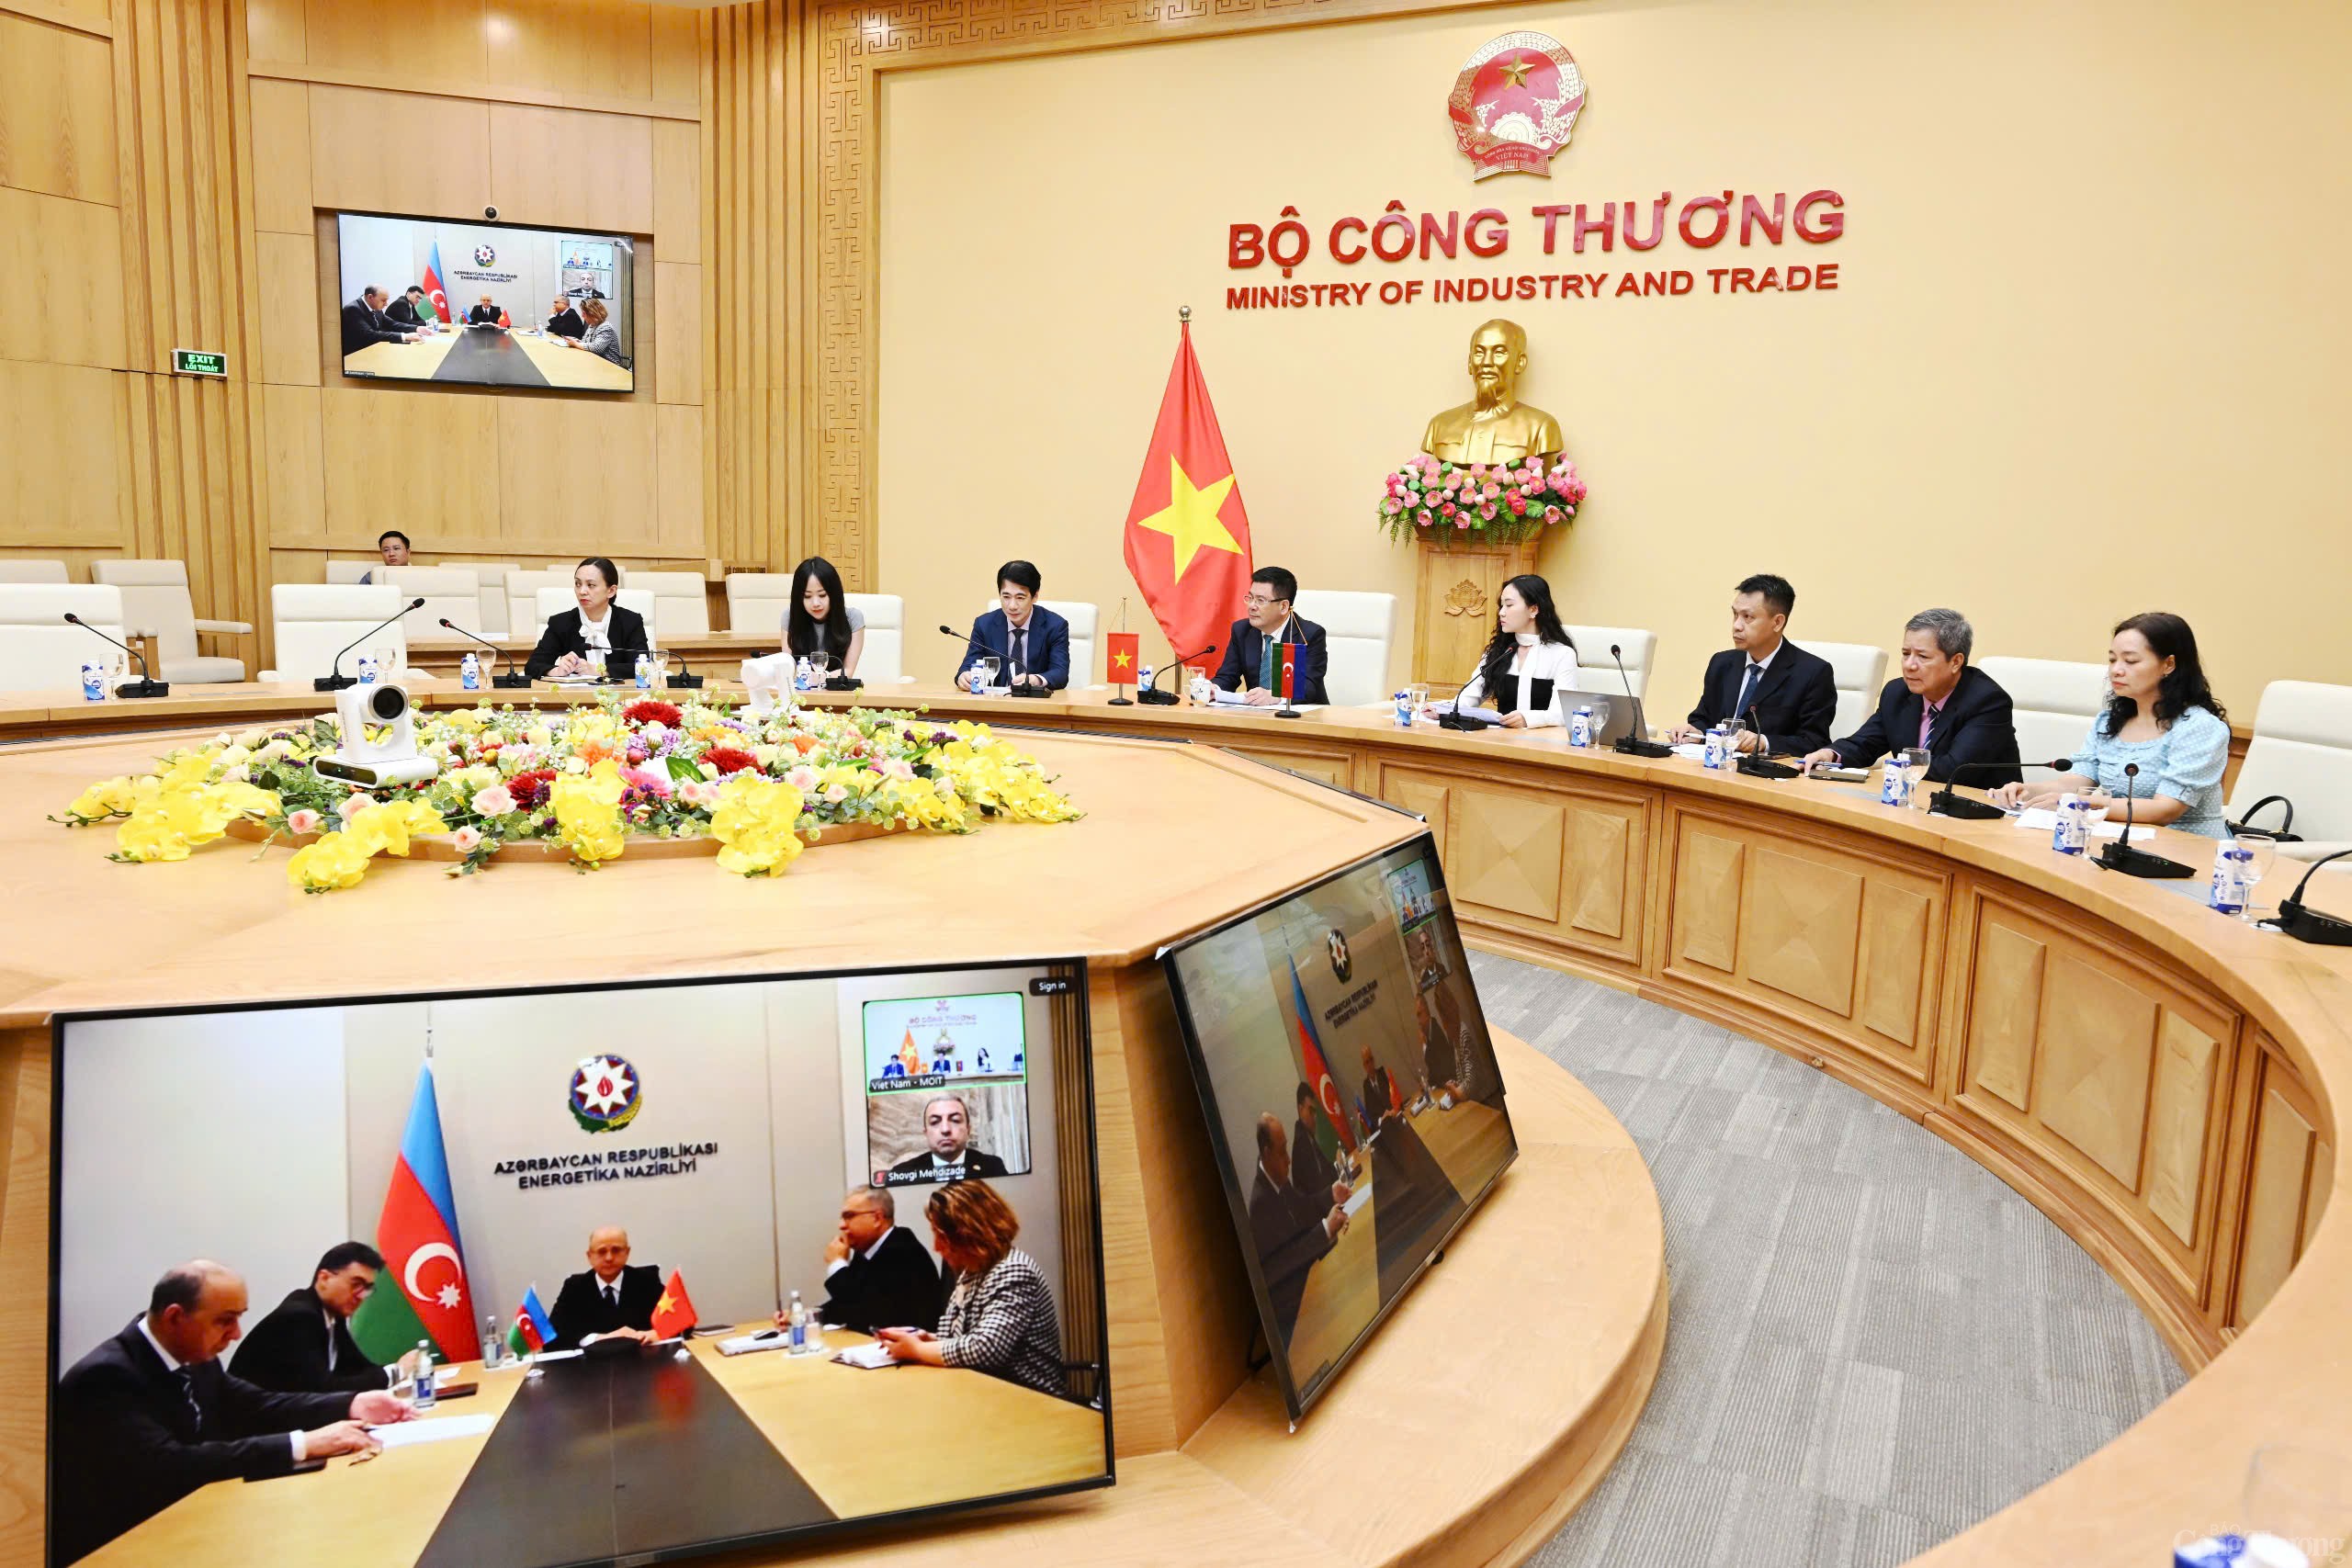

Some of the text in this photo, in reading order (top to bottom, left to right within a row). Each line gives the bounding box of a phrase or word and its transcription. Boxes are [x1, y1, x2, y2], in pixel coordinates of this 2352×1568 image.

[1228, 190, 1845, 278] BỘ CÔNG THƯƠNG
[1227, 264, 1839, 309] MINISTRY OF INDUSTRY AND TRADE
[187, 354, 215, 364] EXIT
[1038, 980, 1067, 992] Sign in
[871, 1080, 888, 1090] Viet
[890, 1079, 911, 1089] Nam
[919, 1076, 944, 1087] MOIT
[493, 1142, 718, 1175] AZƏRBAYCAN RESPUBLİKASI
[518, 1157, 696, 1190] ENERGETİKA NAZİRLİYİ
[888, 1166, 967, 1182] Shovgi Mehdizade
